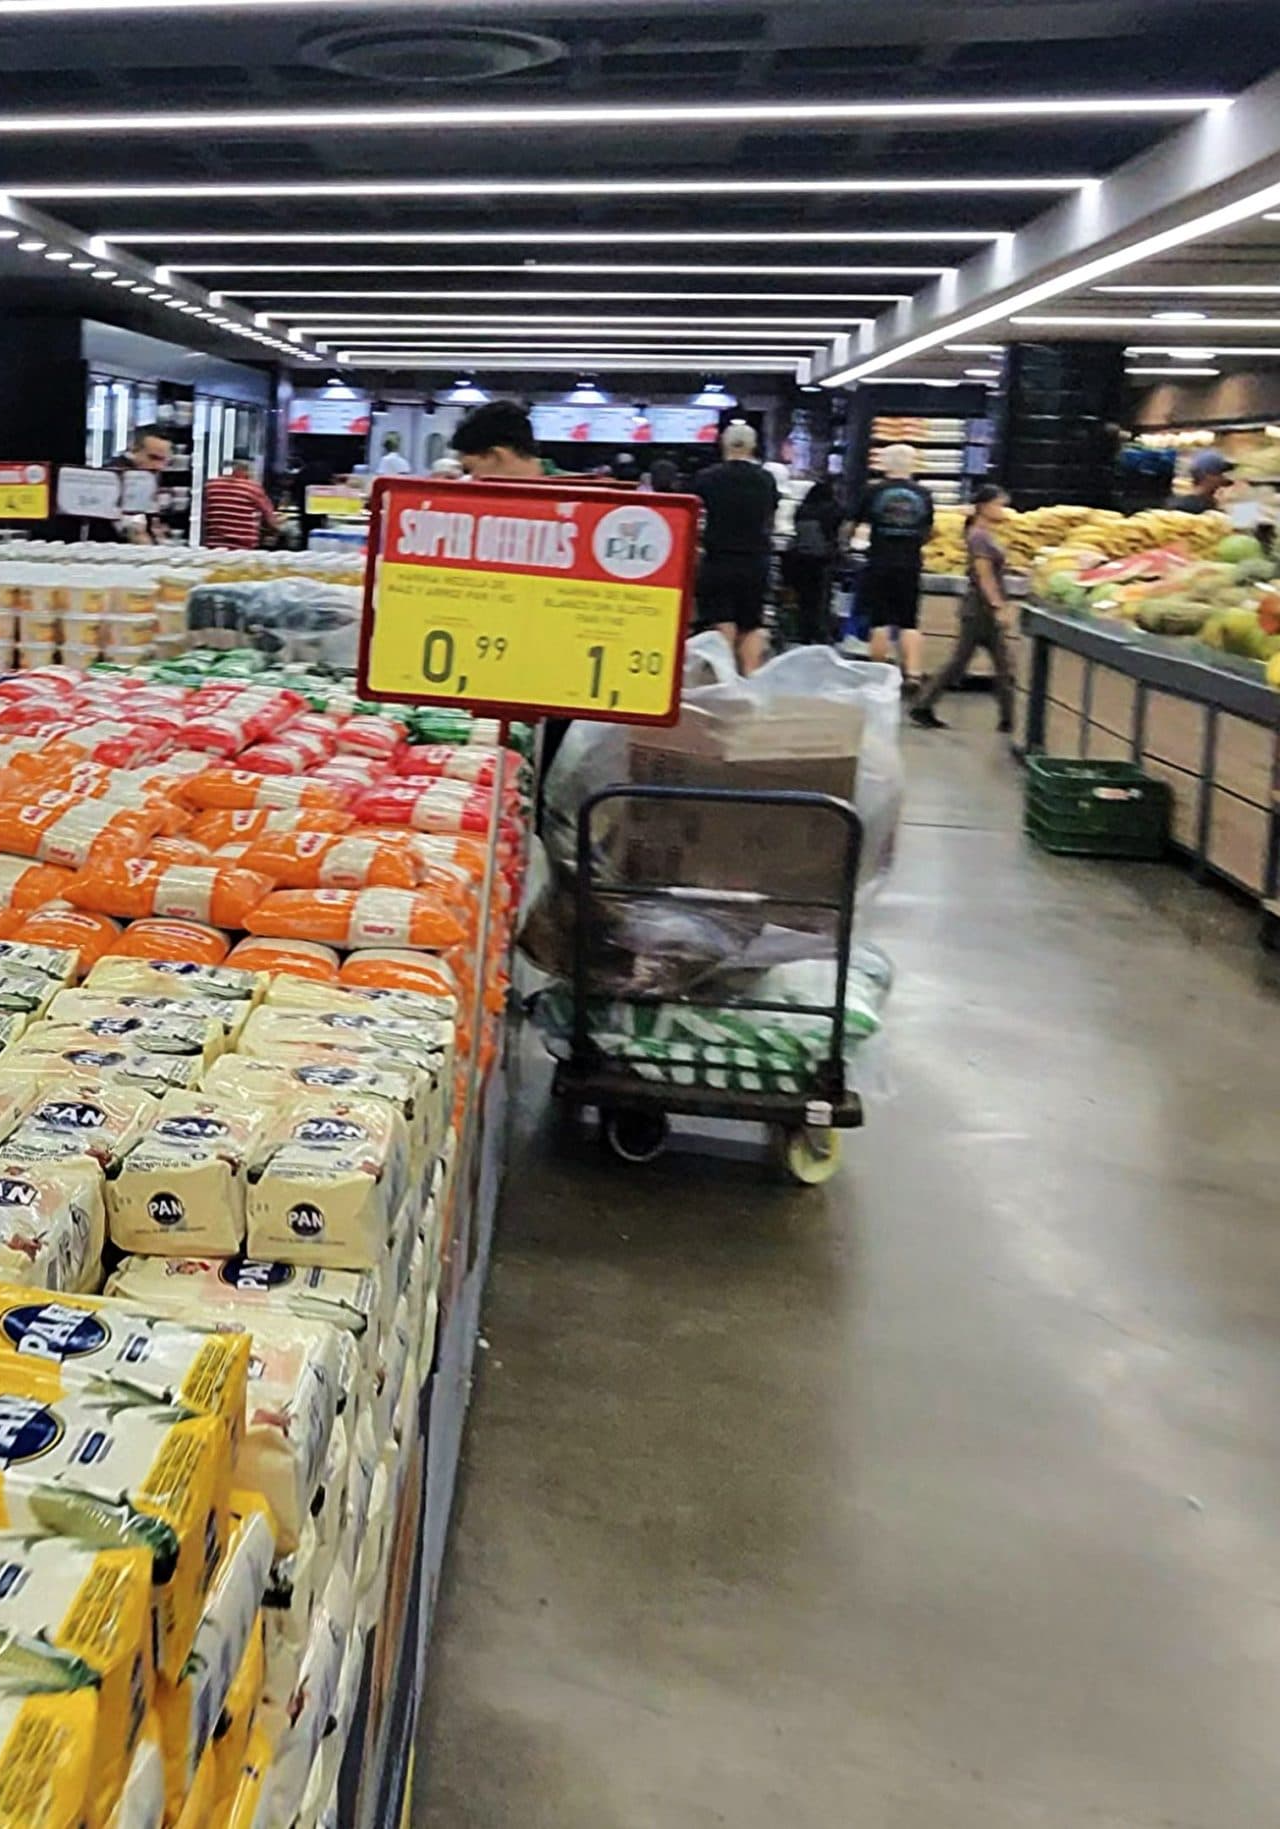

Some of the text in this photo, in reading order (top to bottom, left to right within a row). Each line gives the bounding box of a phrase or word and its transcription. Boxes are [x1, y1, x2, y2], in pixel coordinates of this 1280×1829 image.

[35, 1103, 106, 1126] PAN
[148, 1201, 184, 1217] PAN
[288, 1211, 325, 1228] PAN
[18, 1304, 94, 1360] PAN
